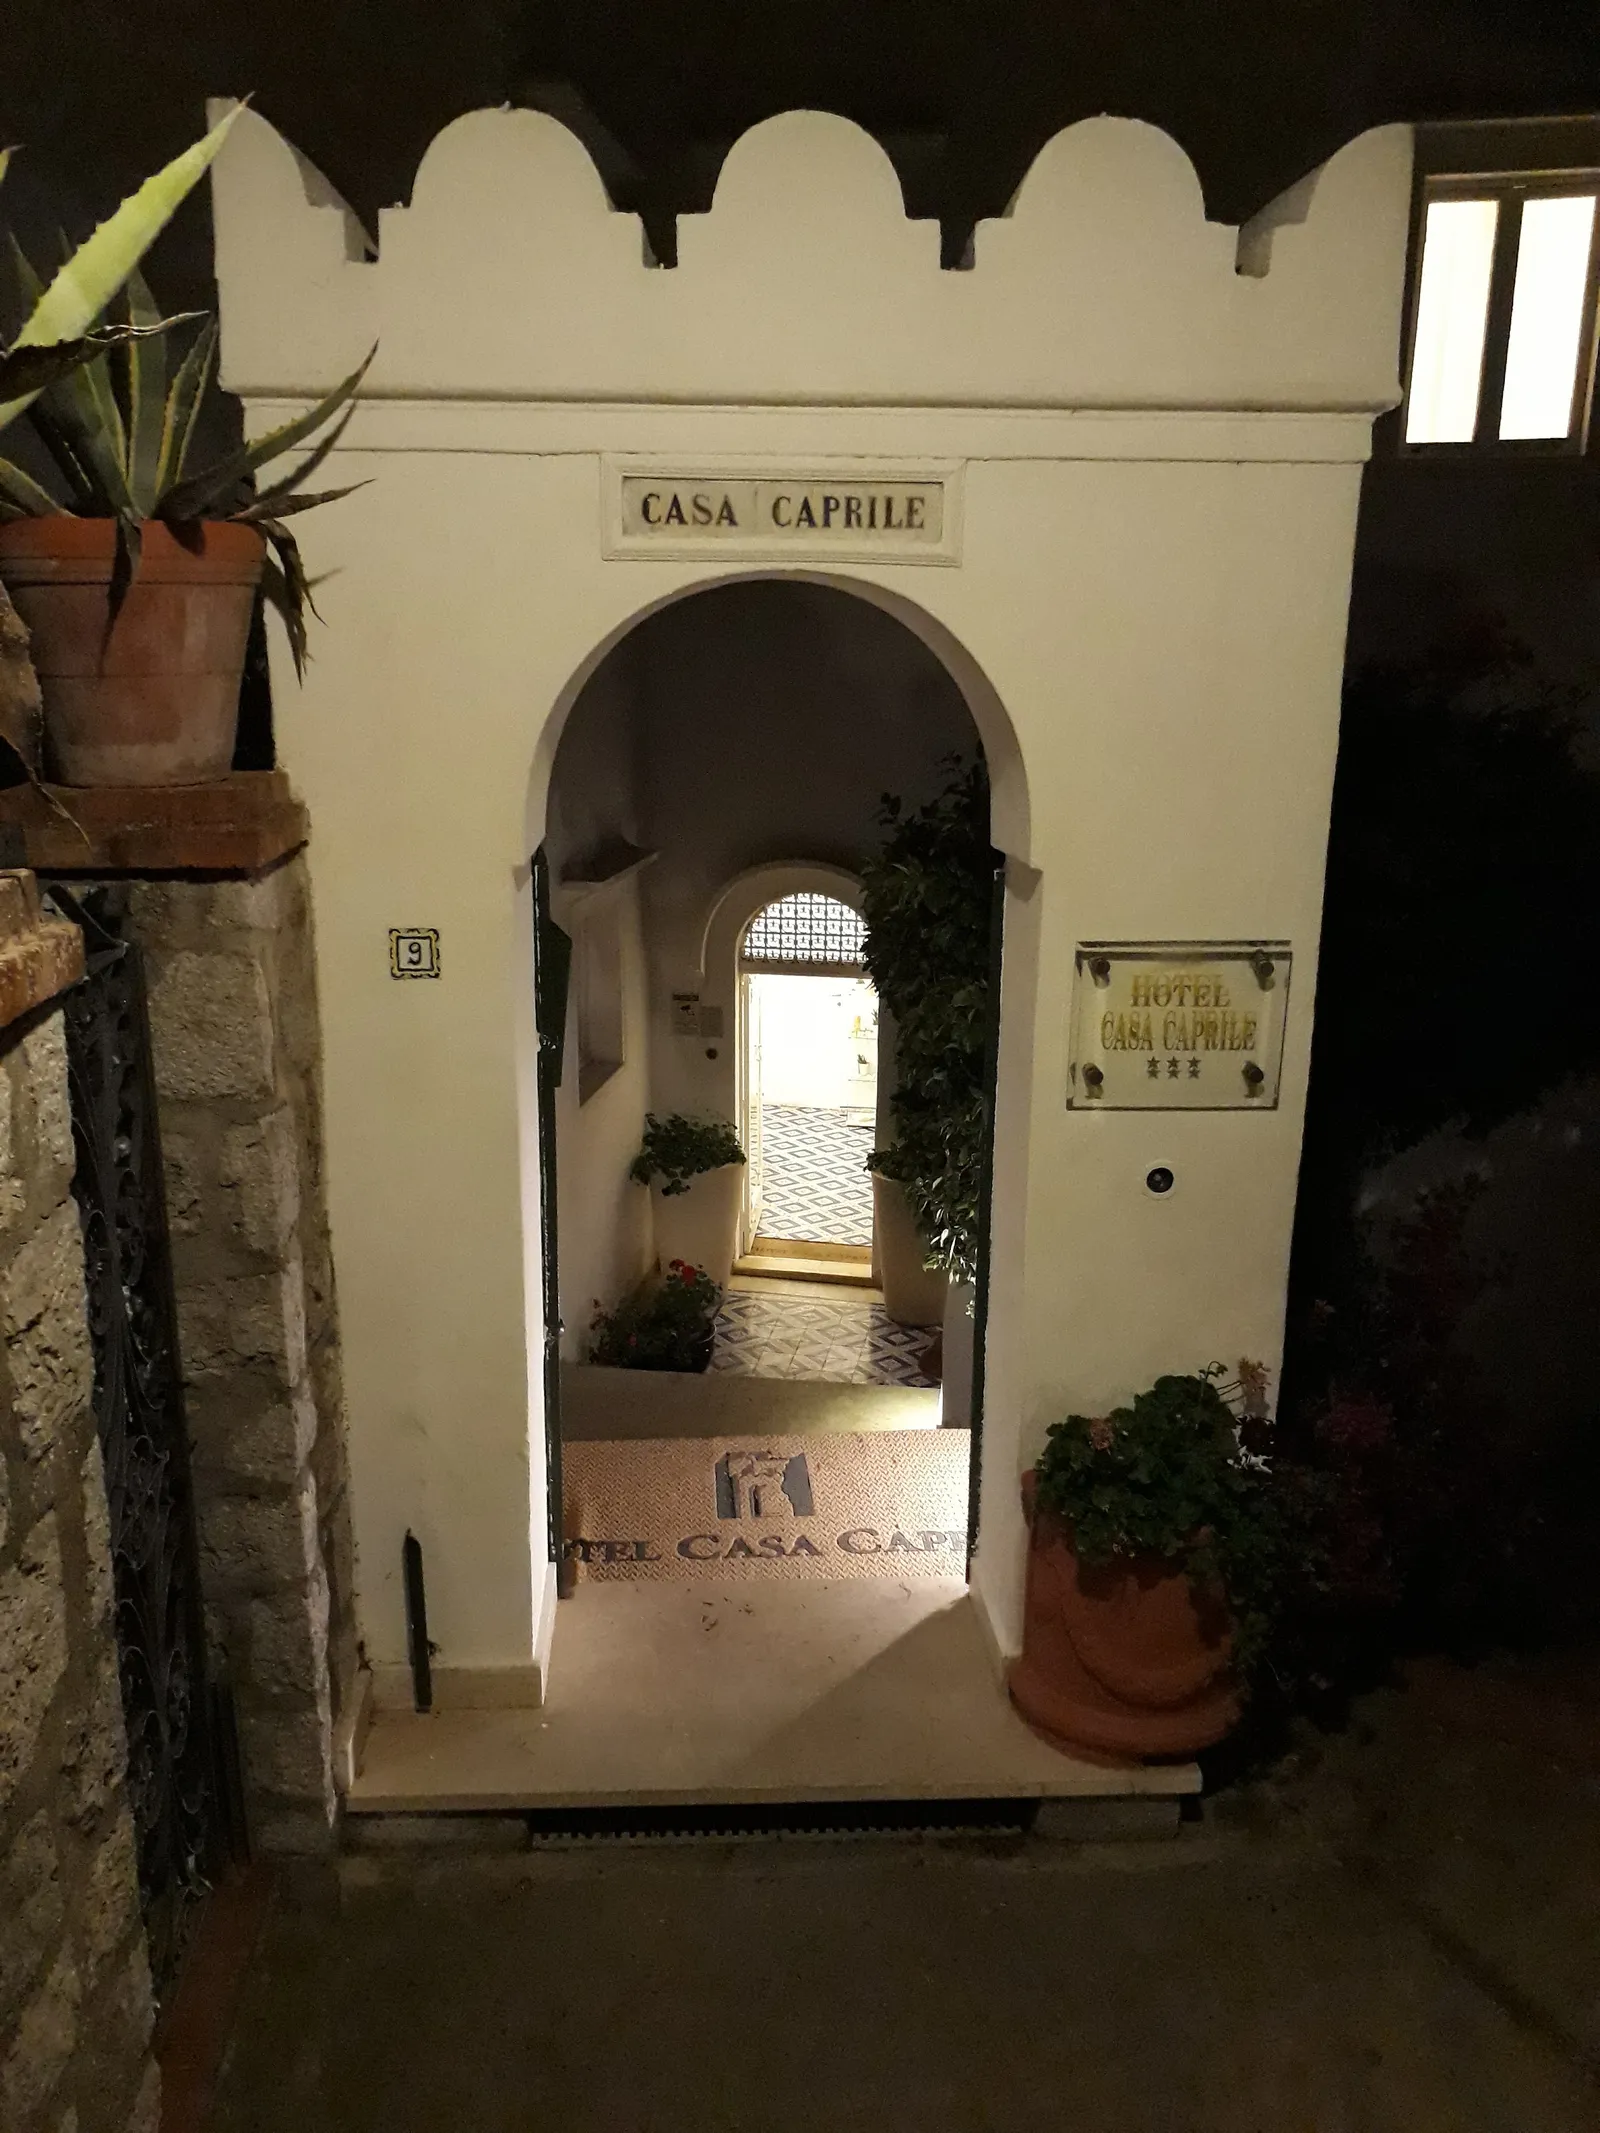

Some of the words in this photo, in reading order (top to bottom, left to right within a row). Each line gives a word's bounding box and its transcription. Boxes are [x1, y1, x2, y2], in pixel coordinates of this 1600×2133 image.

[641, 493, 738, 527] CASA
[771, 495, 925, 530] CAPRILE
[408, 941, 421, 965] 9
[1130, 974, 1231, 1008] HOTEL
[1101, 1010, 1154, 1051] CASA
[1163, 1010, 1257, 1051] CAPRILE
[565, 1538, 661, 1563] TEL
[676, 1533, 823, 1560] CASA
